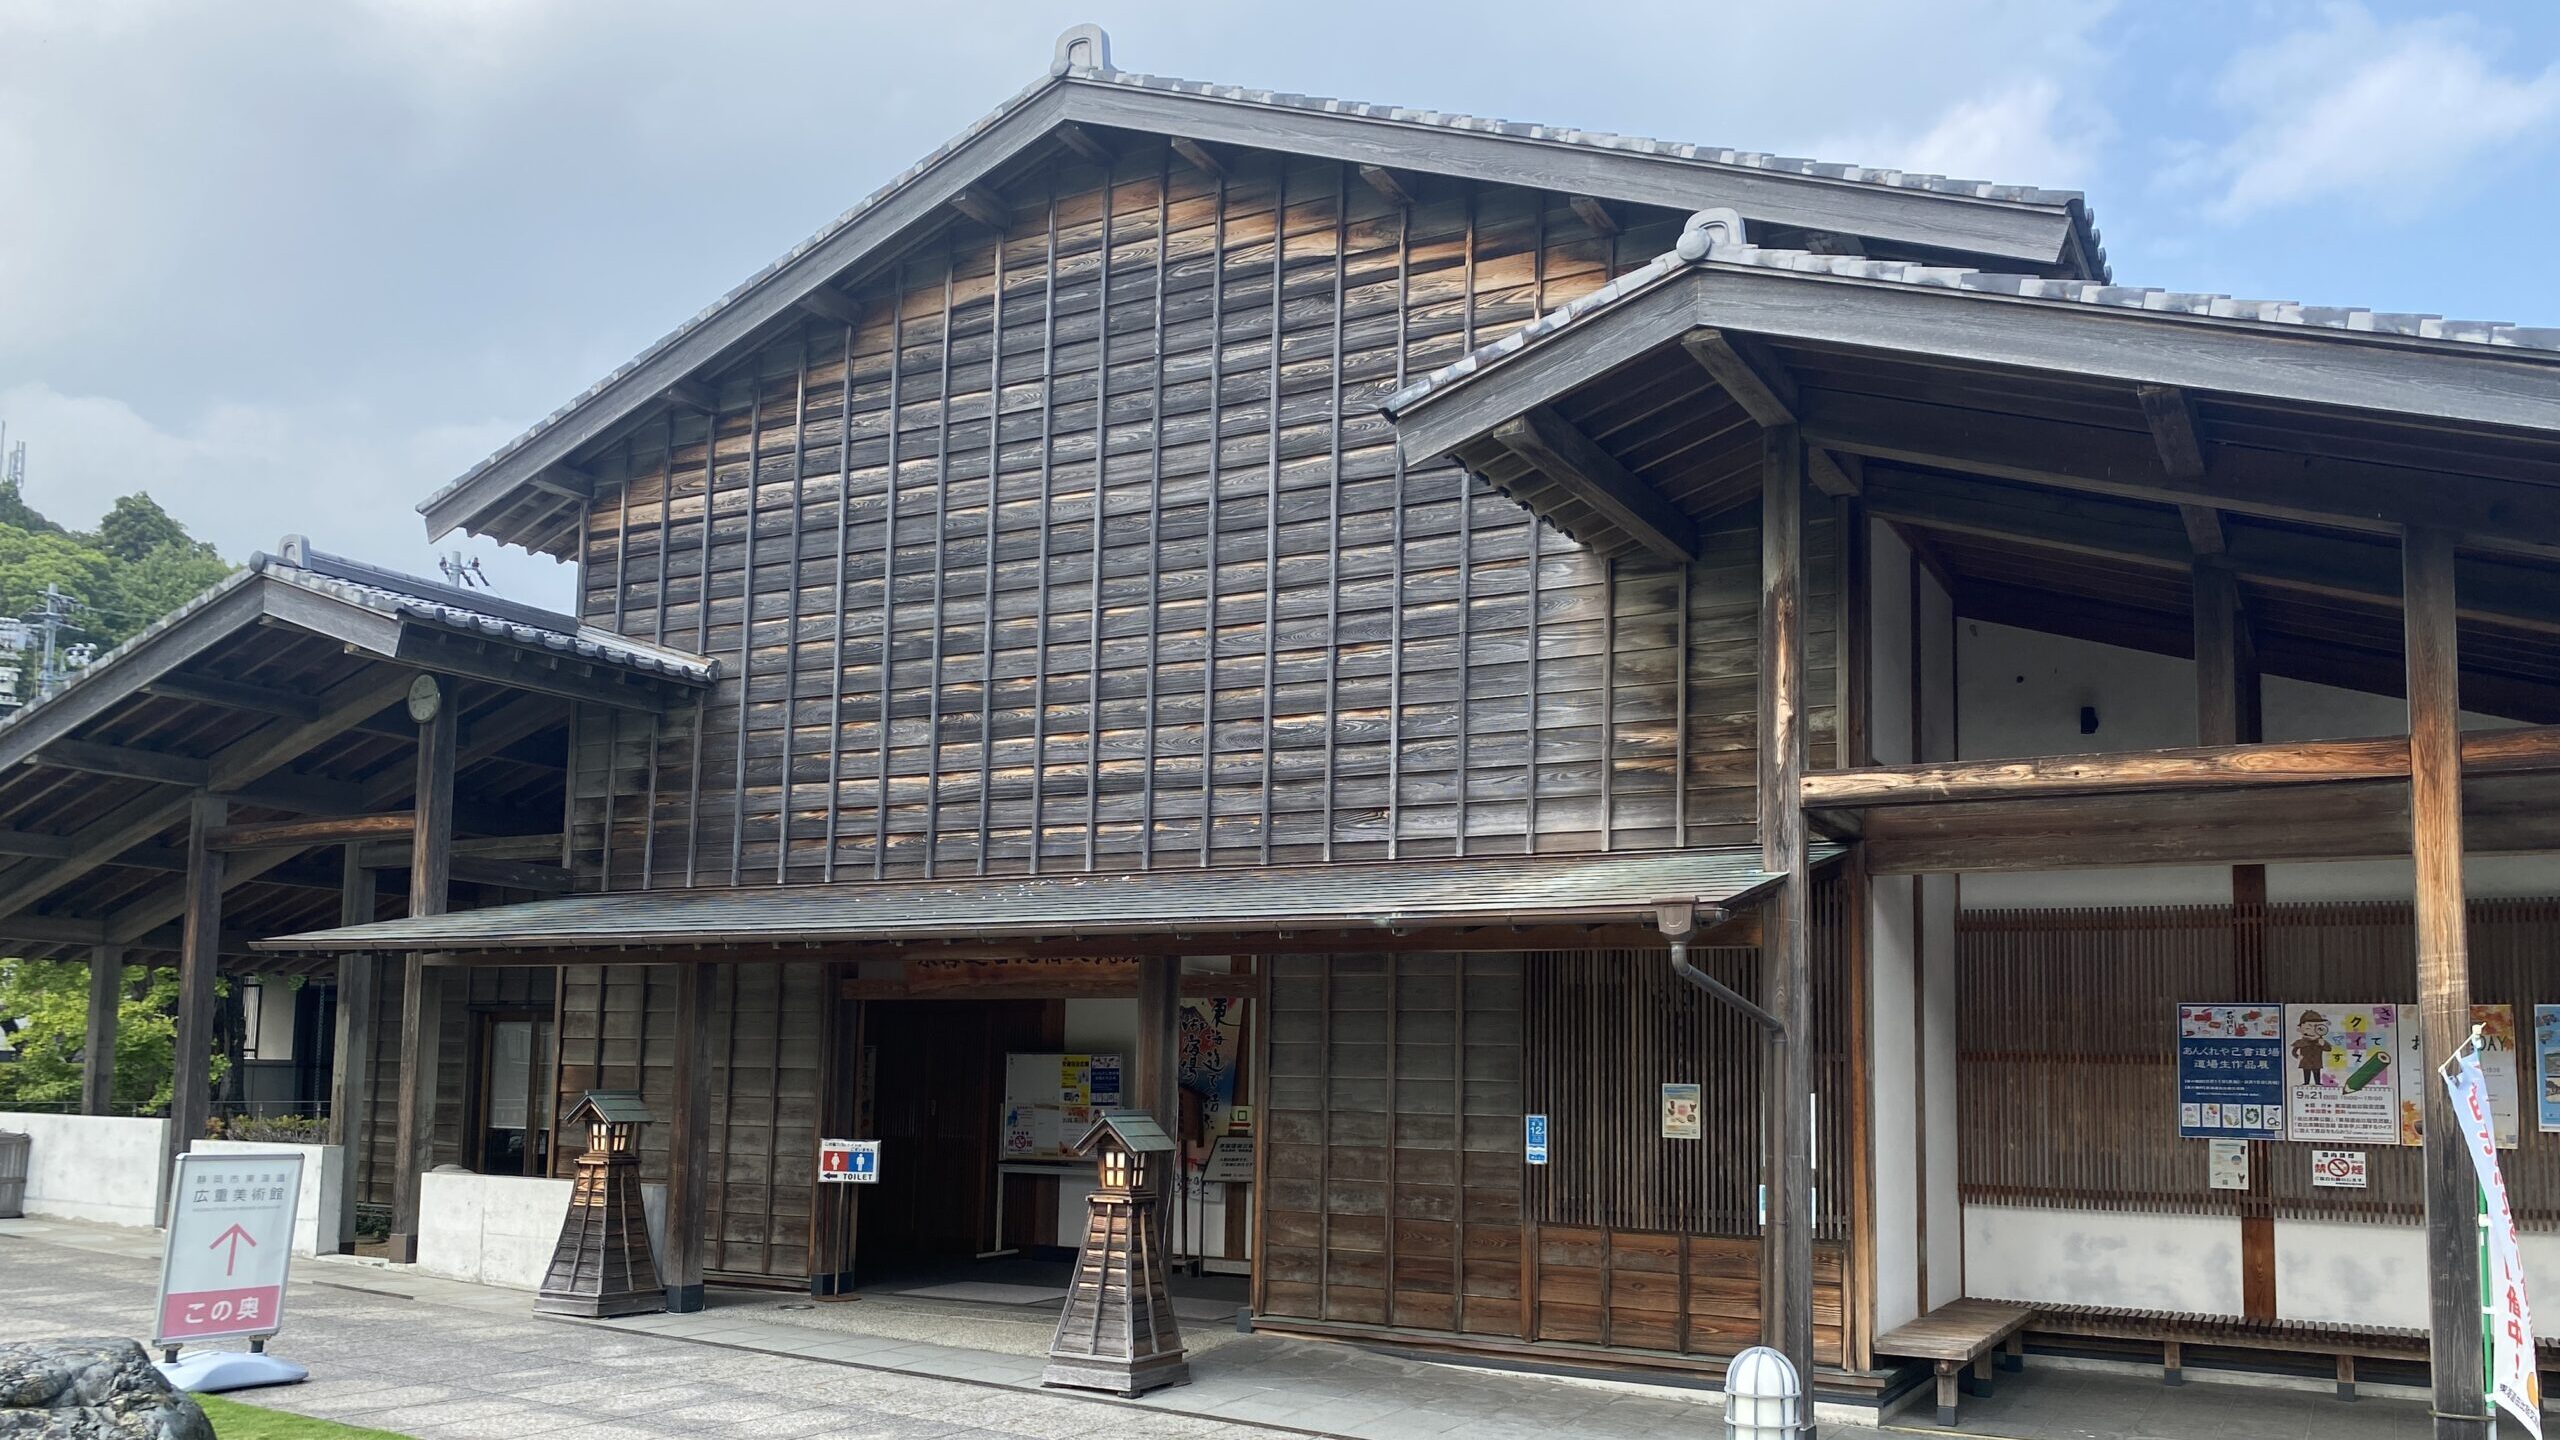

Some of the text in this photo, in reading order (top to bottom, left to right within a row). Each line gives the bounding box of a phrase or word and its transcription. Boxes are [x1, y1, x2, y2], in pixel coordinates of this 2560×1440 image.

[2194, 1059, 2270, 1069] 道場生作品展
[2315, 1163, 2364, 1175] 禁 煙
[193, 1186, 285, 1202] 広重美術館
[185, 1296, 259, 1324] この奥
